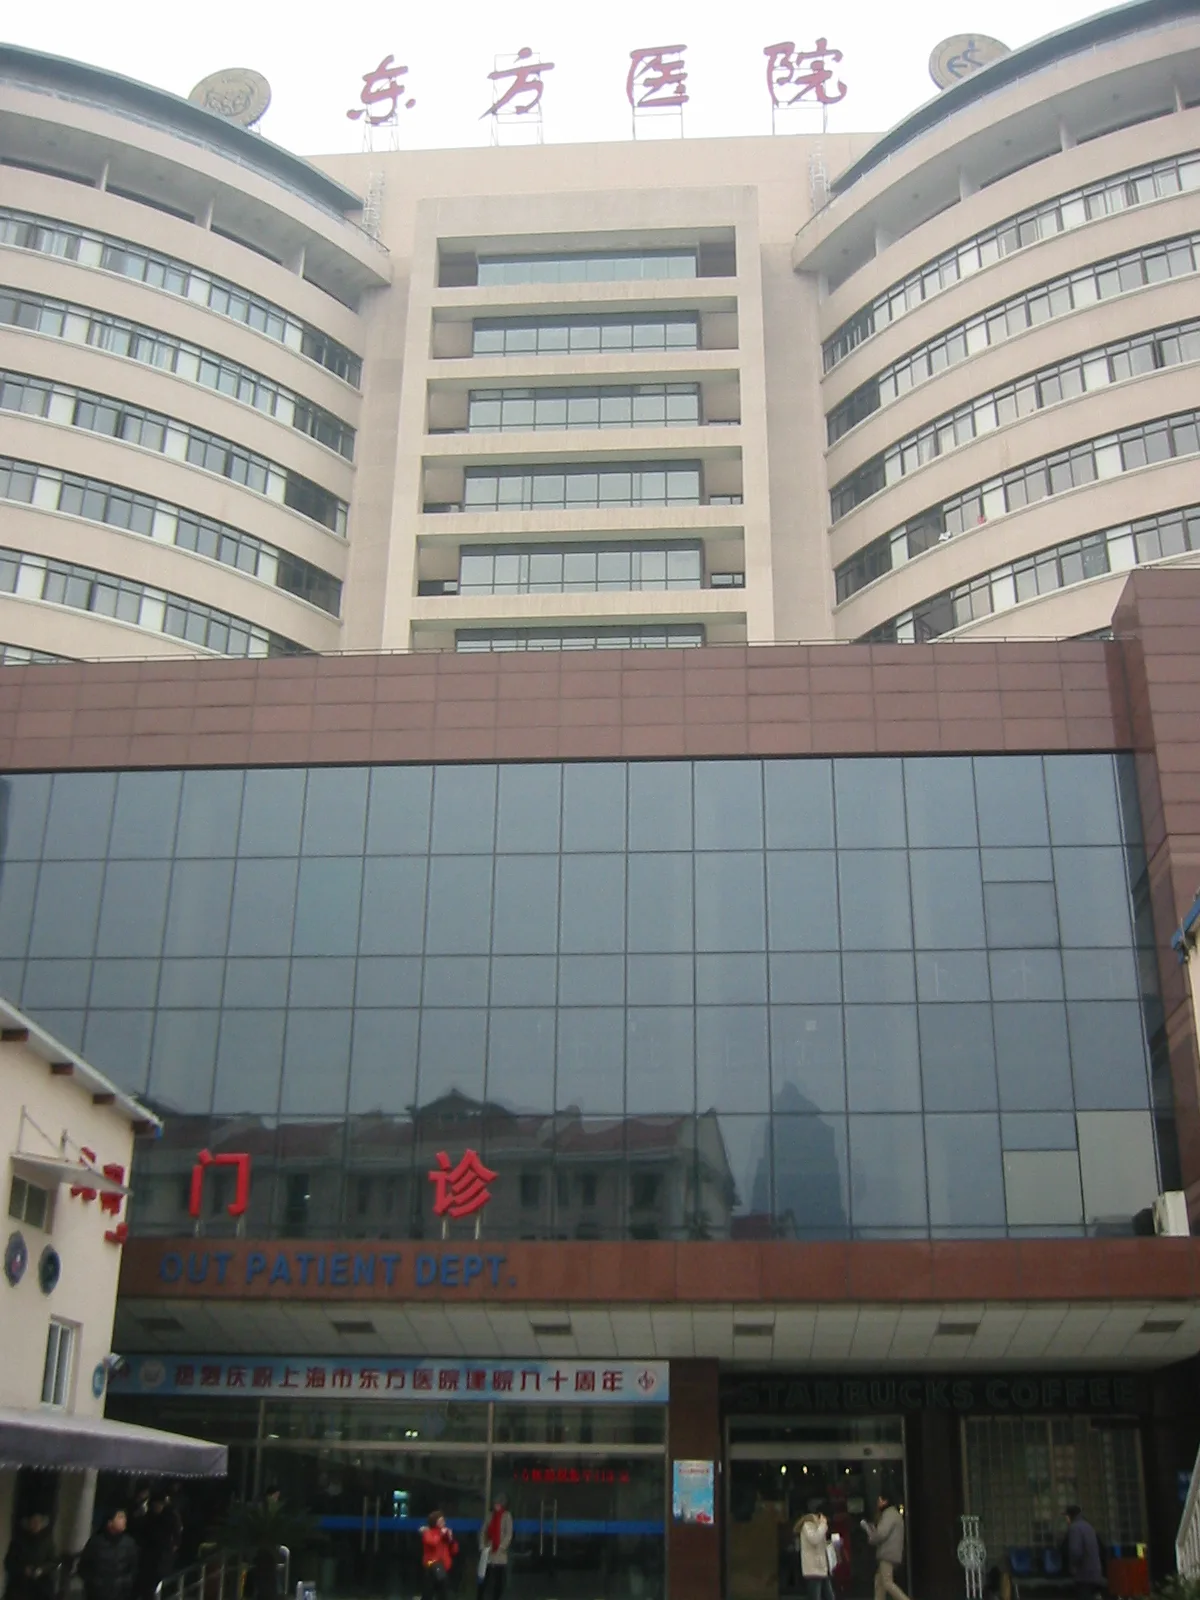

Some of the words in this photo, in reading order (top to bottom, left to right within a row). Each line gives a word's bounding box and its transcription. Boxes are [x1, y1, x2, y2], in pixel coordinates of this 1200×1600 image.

[347, 38, 847, 124] 东方医院
[188, 1149, 498, 1218] 门诊
[160, 1252, 234, 1284] OUT
[246, 1252, 400, 1286] PATIENT
[415, 1253, 517, 1288] DEPT.
[736, 1379, 974, 1410] STARBUCKS
[985, 1377, 1137, 1409] COFFEE
